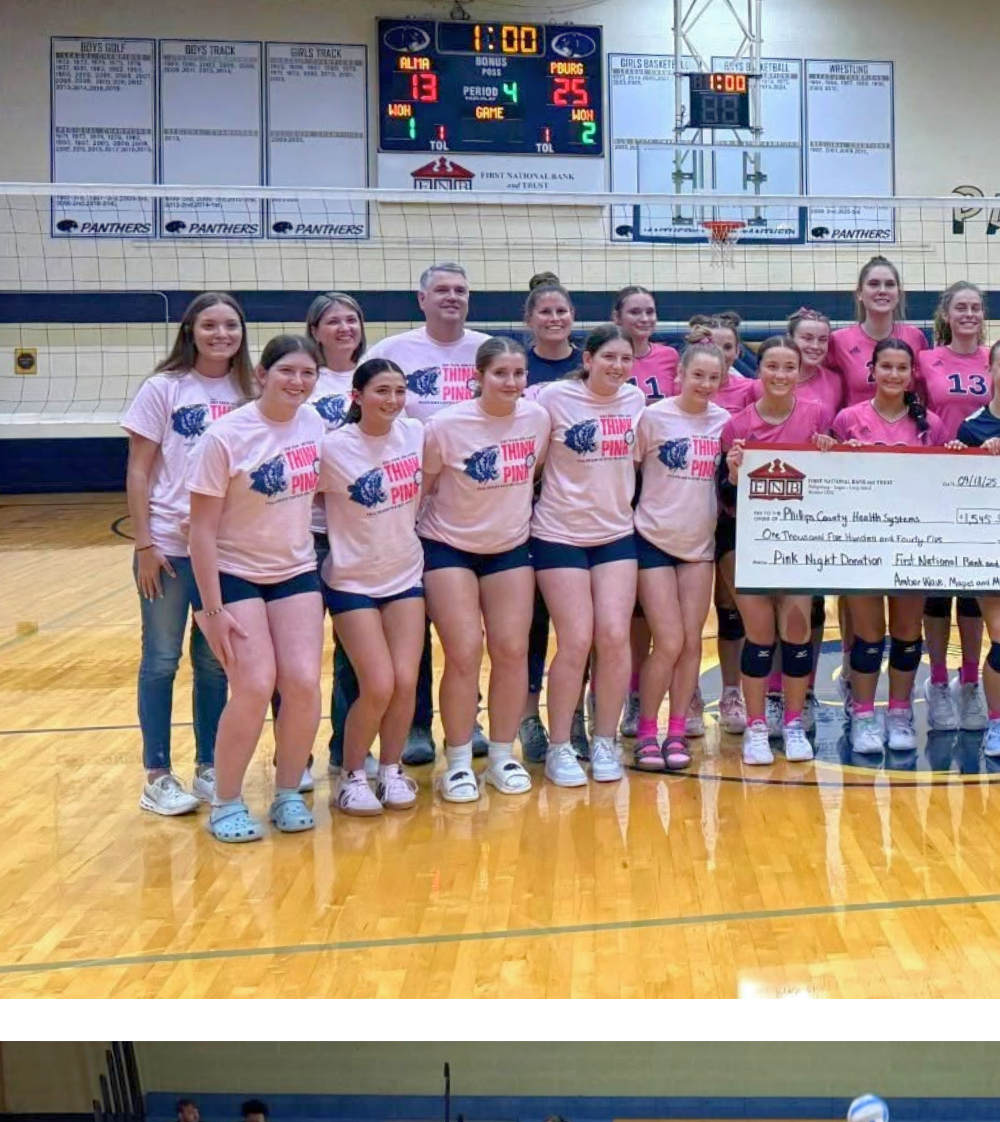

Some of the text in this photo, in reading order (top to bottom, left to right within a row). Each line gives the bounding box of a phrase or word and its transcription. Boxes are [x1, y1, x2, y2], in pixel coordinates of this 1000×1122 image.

[474, 25, 537, 53] 1:00
[209, 46, 236, 57] TRACK
[317, 48, 342, 59] TRACK
[400, 57, 430, 70] ALMA
[475, 57, 508, 67] BONUS
[550, 62, 584, 75] PBURG
[643, 58, 689, 70] BASKETBLL
[829, 64, 869, 74] WRESTLING
[412, 73, 438, 101] 13
[709, 75, 746, 92] 1:00
[463, 82, 519, 103] PERIOD 4
[553, 77, 588, 106] 25
[475, 106, 505, 120] GAME
[409, 118, 416, 140] 1
[440, 125, 445, 140] 1
[544, 128, 550, 142] 1
[582, 121, 597, 144] 2
[429, 141, 450, 151] TOL
[536, 143, 555, 153] TOL
[480, 172, 575, 181] FIRST NATIONAL BANK
[80, 222, 152, 234] PANTHERS
[189, 222, 259, 235] PANTHERS
[294, 223, 364, 236] PANTHERS
[831, 229, 891, 240] PANTHERS
[948, 374, 987, 395] 13
[600, 417, 632, 436] THINK
[500, 438, 536, 461] THINK
[602, 440, 629, 456] PINK
[503, 465, 530, 484] PINK
[753, 480, 800, 494] FNB
[817, 511, 848, 527] County
[852, 511, 881, 522] Health
[883, 513, 920, 527] Systems
[762, 527, 780, 540] One
[781, 530, 824, 541] Thousand
[773, 549, 883, 572] Pink Night Donation
[895, 552, 999, 568] First National Bank and
[894, 571, 921, 587] Amber
[949, 576, 975, 590] Mapes
[976, 578, 990, 586] and
